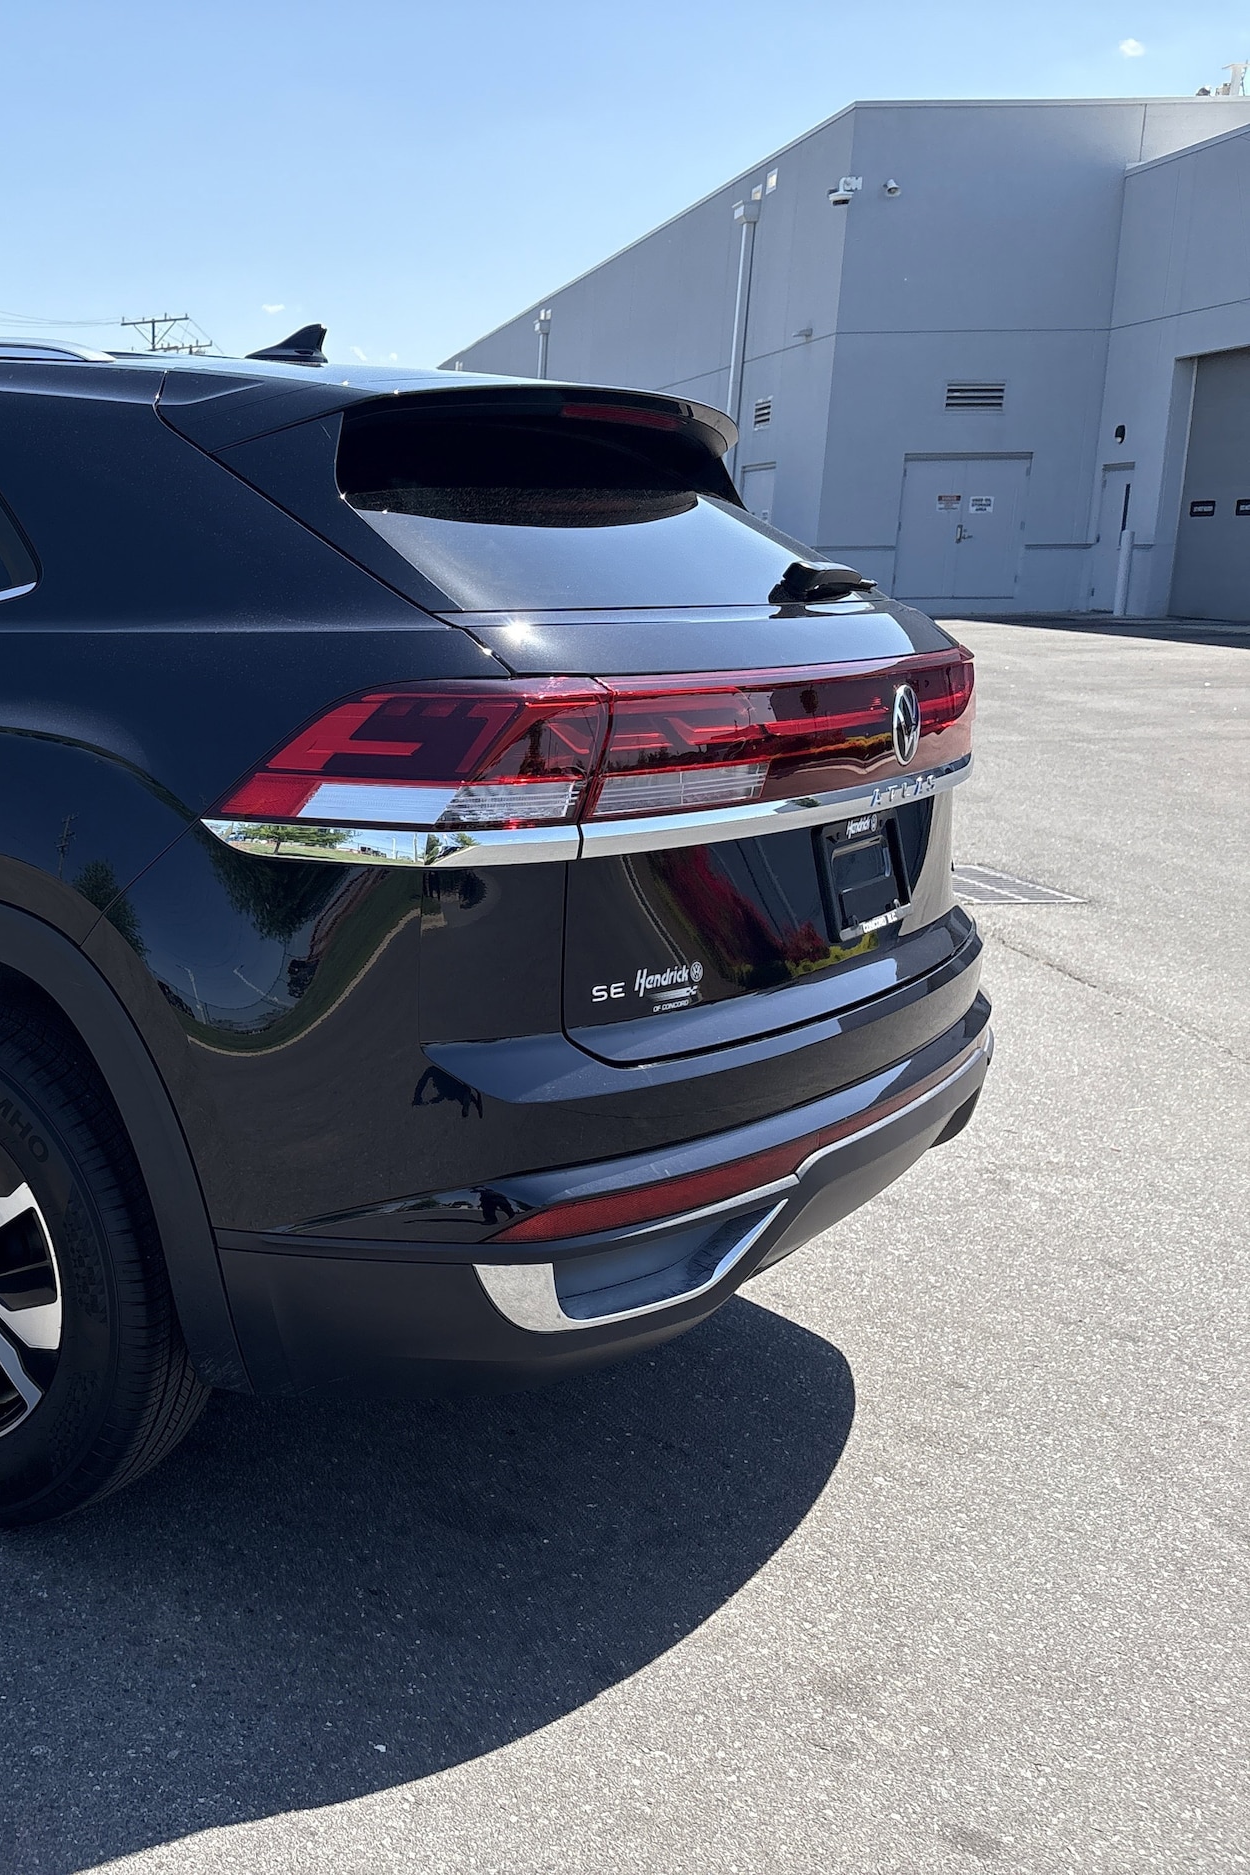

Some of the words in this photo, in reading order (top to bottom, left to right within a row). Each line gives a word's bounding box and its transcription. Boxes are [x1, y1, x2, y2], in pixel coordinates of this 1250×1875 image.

[870, 774, 935, 807] ATLAS
[592, 982, 625, 1002] SE
[634, 965, 690, 998] Hendrick
[661, 999, 690, 1011] CONCORD
